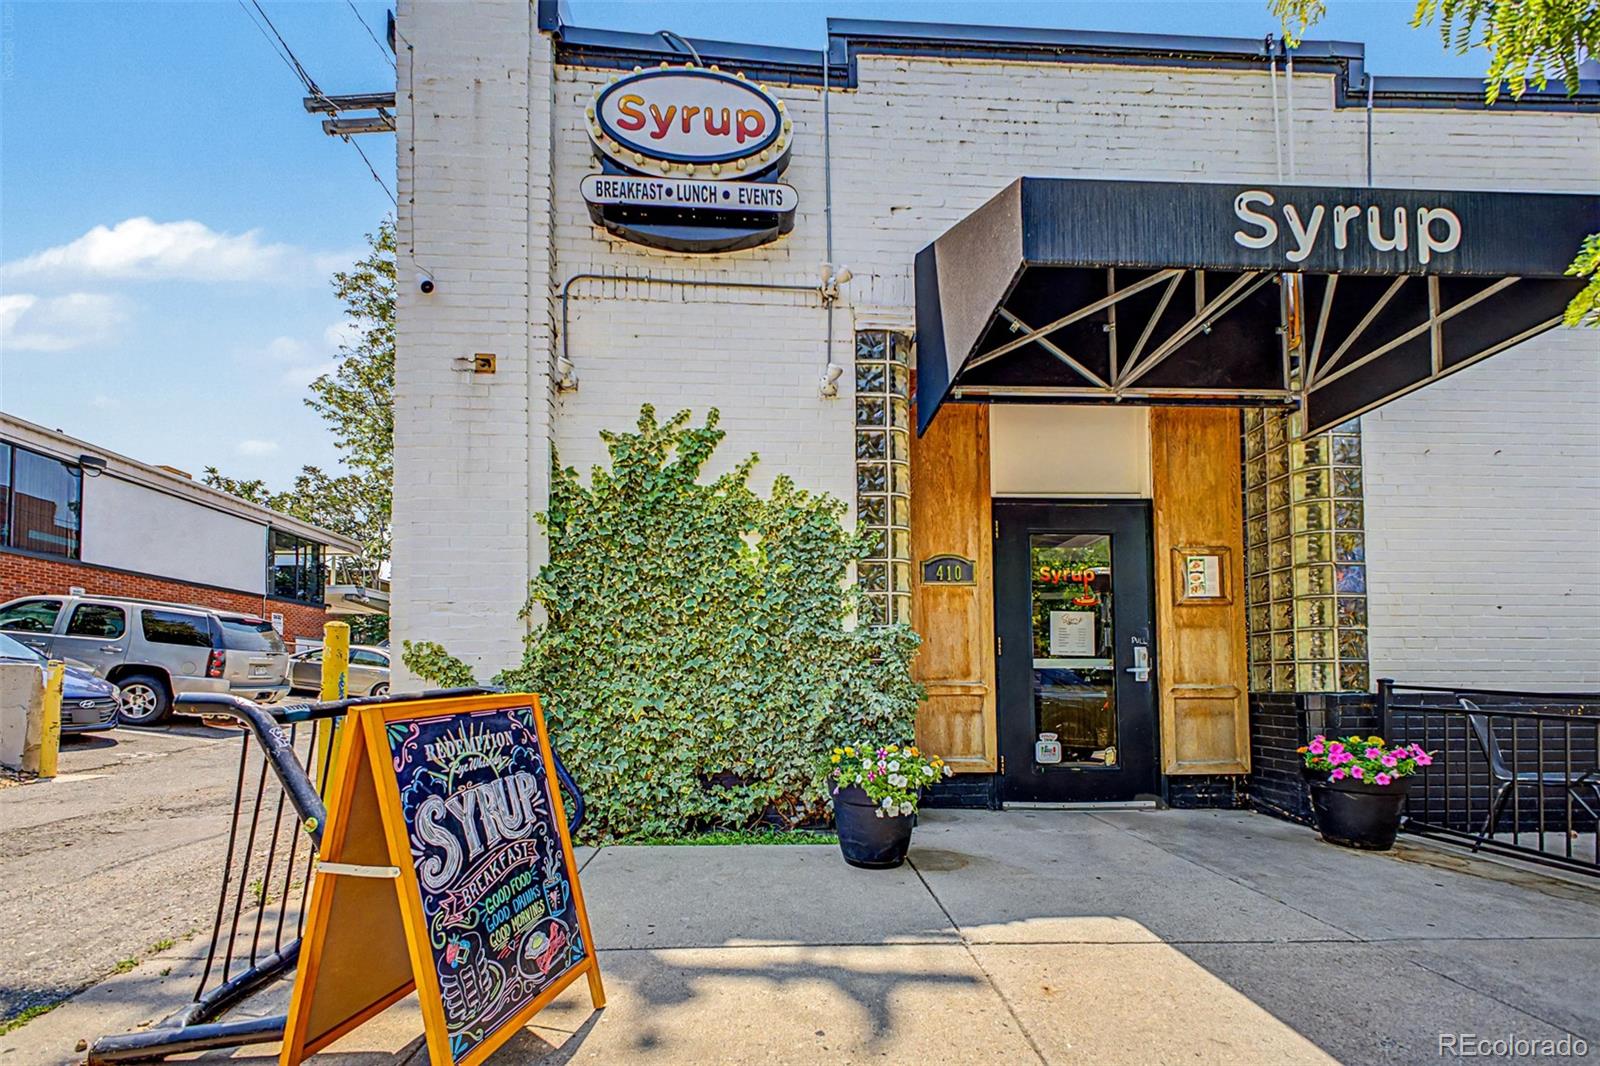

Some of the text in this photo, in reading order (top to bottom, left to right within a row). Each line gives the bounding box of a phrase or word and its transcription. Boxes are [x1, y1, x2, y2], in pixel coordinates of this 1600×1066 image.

[616, 94, 766, 144] Syrup
[595, 180, 783, 206] BREAKFAST LUNCH EVENTS
[1233, 190, 1463, 265] Syrup
[935, 564, 962, 581] 410
[1039, 566, 1096, 585] Syrup
[423, 731, 514, 762] REDEMPTION
[415, 770, 537, 894] SYRUP
[461, 842, 528, 907] BREAKFAST
[485, 871, 532, 915] GOOD FOOD
[485, 884, 542, 933] GOOD DRINKS
[488, 899, 546, 948] GOOD MORNINGS
